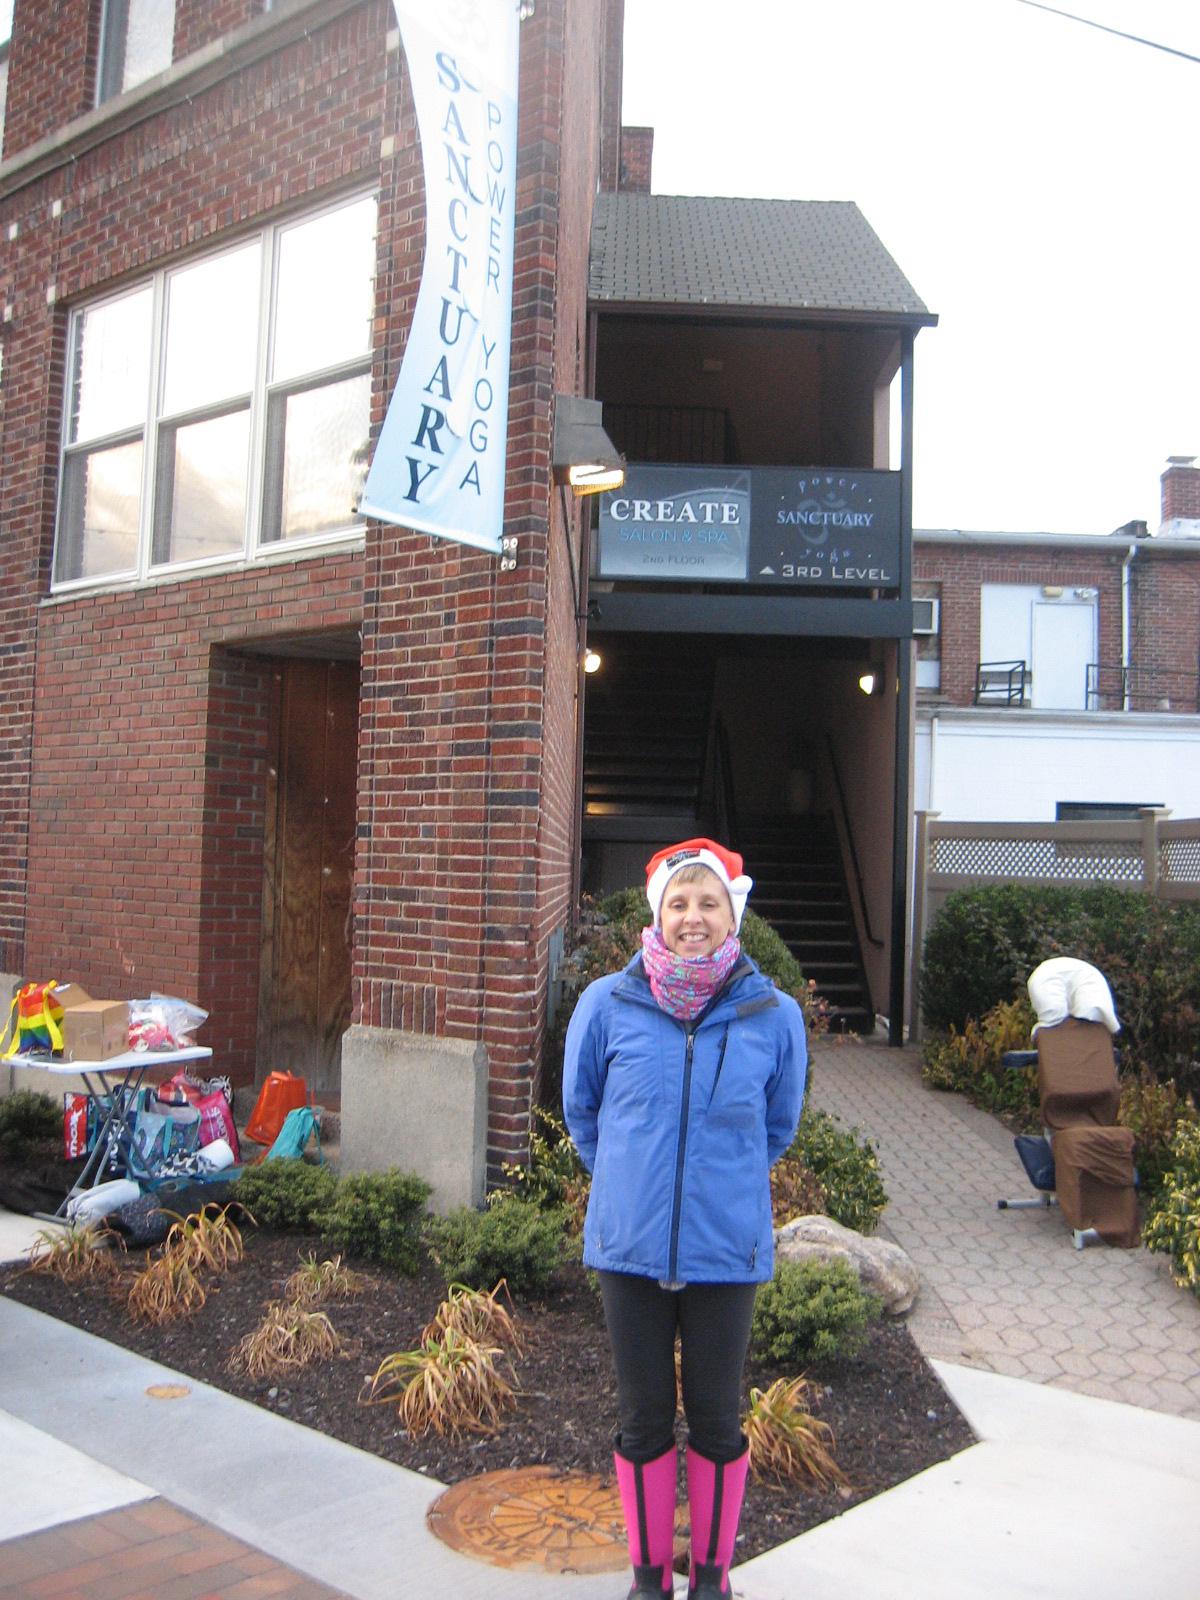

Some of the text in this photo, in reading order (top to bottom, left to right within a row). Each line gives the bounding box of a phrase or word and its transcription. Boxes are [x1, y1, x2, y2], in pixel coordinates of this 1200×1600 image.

[403, 51, 471, 504] SANCTUARY
[459, 101, 506, 496] POWER YOGA
[609, 498, 740, 525] CREATE
[776, 510, 874, 527] SANCTUARY
[620, 527, 729, 545] SALON & SPA
[668, 554, 705, 567] FLOOR
[782, 564, 891, 580] 3RD LEVEL
